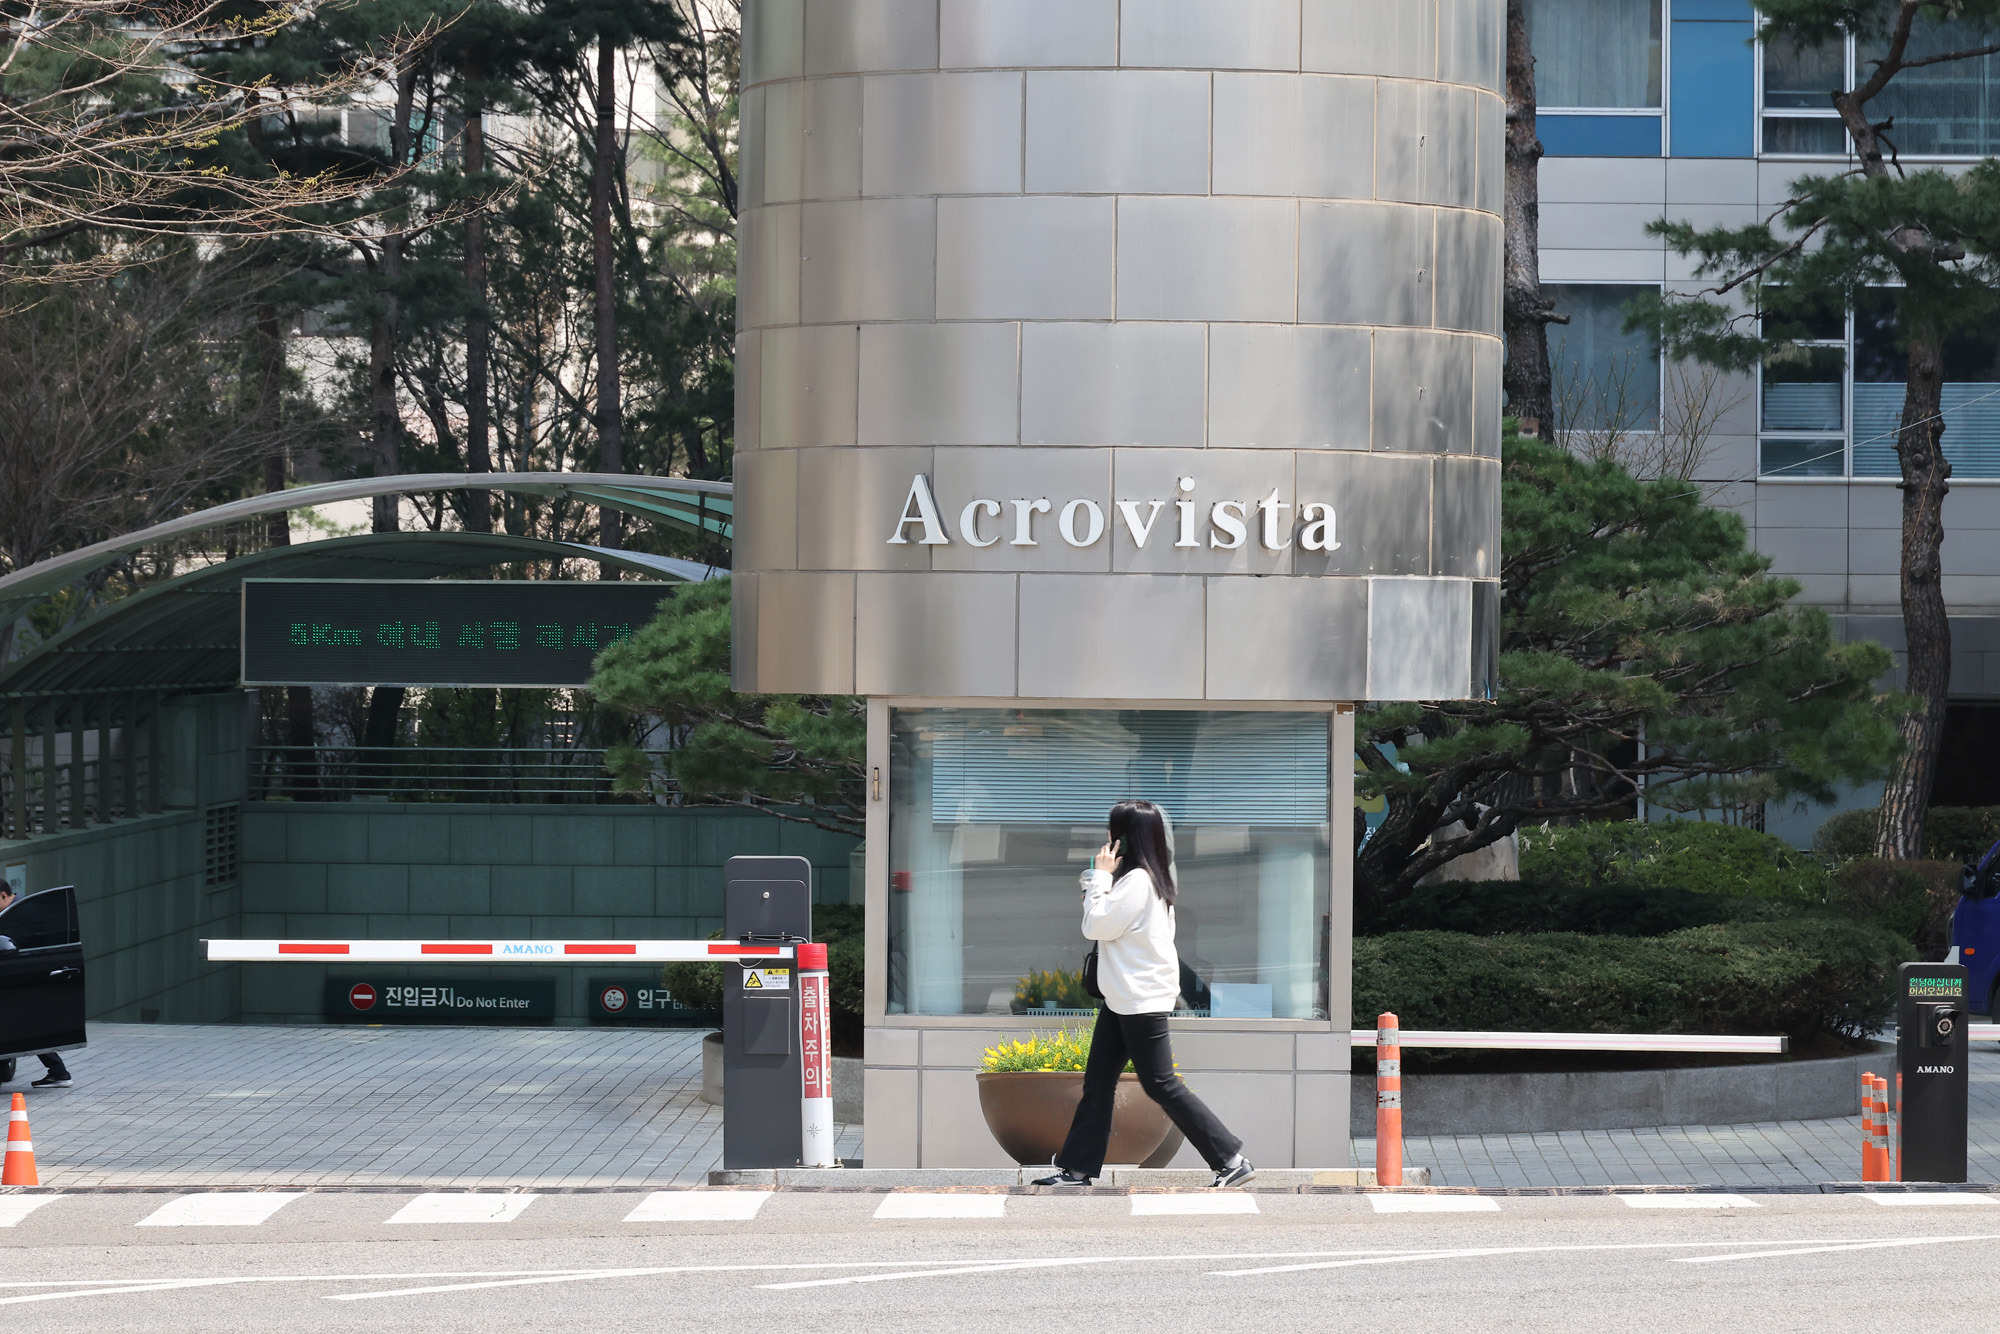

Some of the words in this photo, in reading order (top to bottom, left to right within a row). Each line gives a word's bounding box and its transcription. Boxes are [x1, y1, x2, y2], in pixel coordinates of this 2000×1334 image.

[886, 473, 1342, 551] Acrovista
[288, 622, 362, 646] 5Km
[502, 944, 553, 955] AMANO
[1909, 977, 1962, 987] 안녕하십니까
[1909, 986, 1962, 996] 어서오십시오
[385, 986, 454, 1008] 진입금지
[456, 996, 474, 1008] Do
[476, 996, 497, 1008] Not
[499, 997, 531, 1009] Enter
[637, 989, 672, 1009] 입구
[803, 984, 820, 1089] 출차주의
[1916, 1065, 1955, 1074] AMANO
